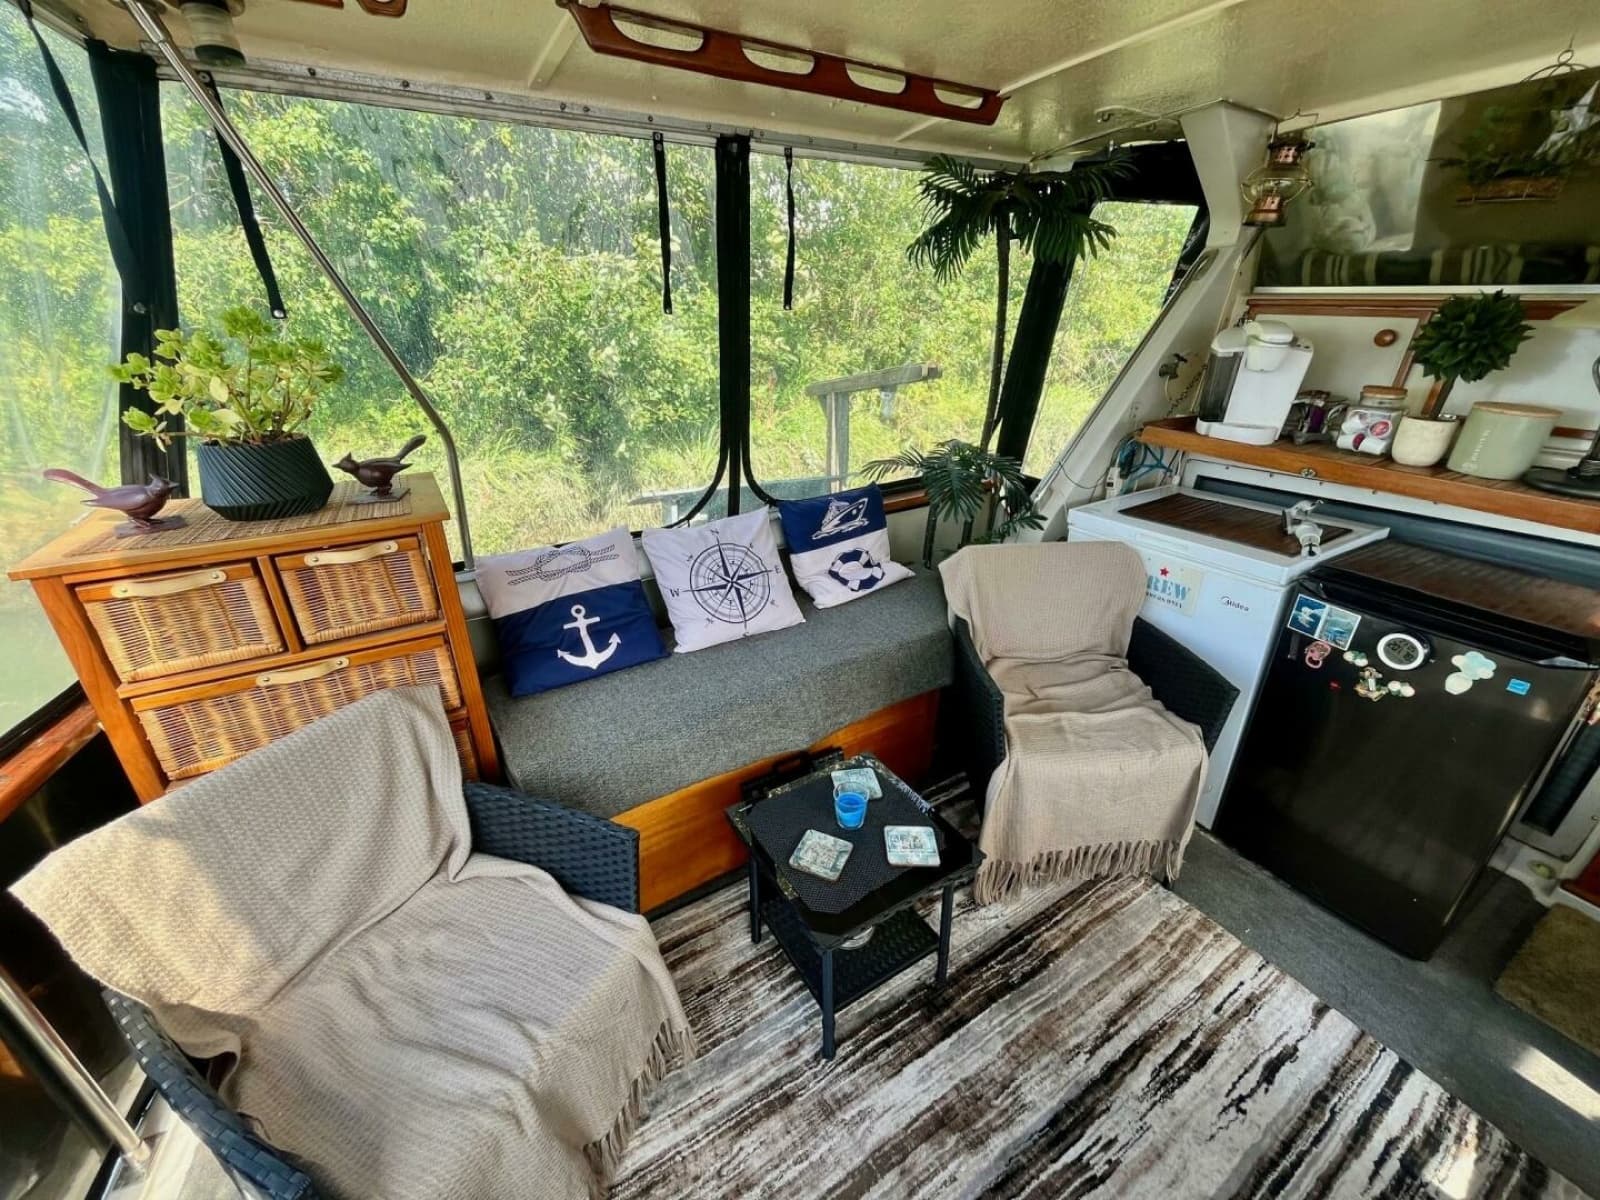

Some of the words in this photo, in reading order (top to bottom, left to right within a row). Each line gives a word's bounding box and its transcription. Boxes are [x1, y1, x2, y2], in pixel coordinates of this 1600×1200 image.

[670, 588, 680, 598] W
[1146, 575, 1191, 600] REW
[1222, 597, 1249, 612] Midea
